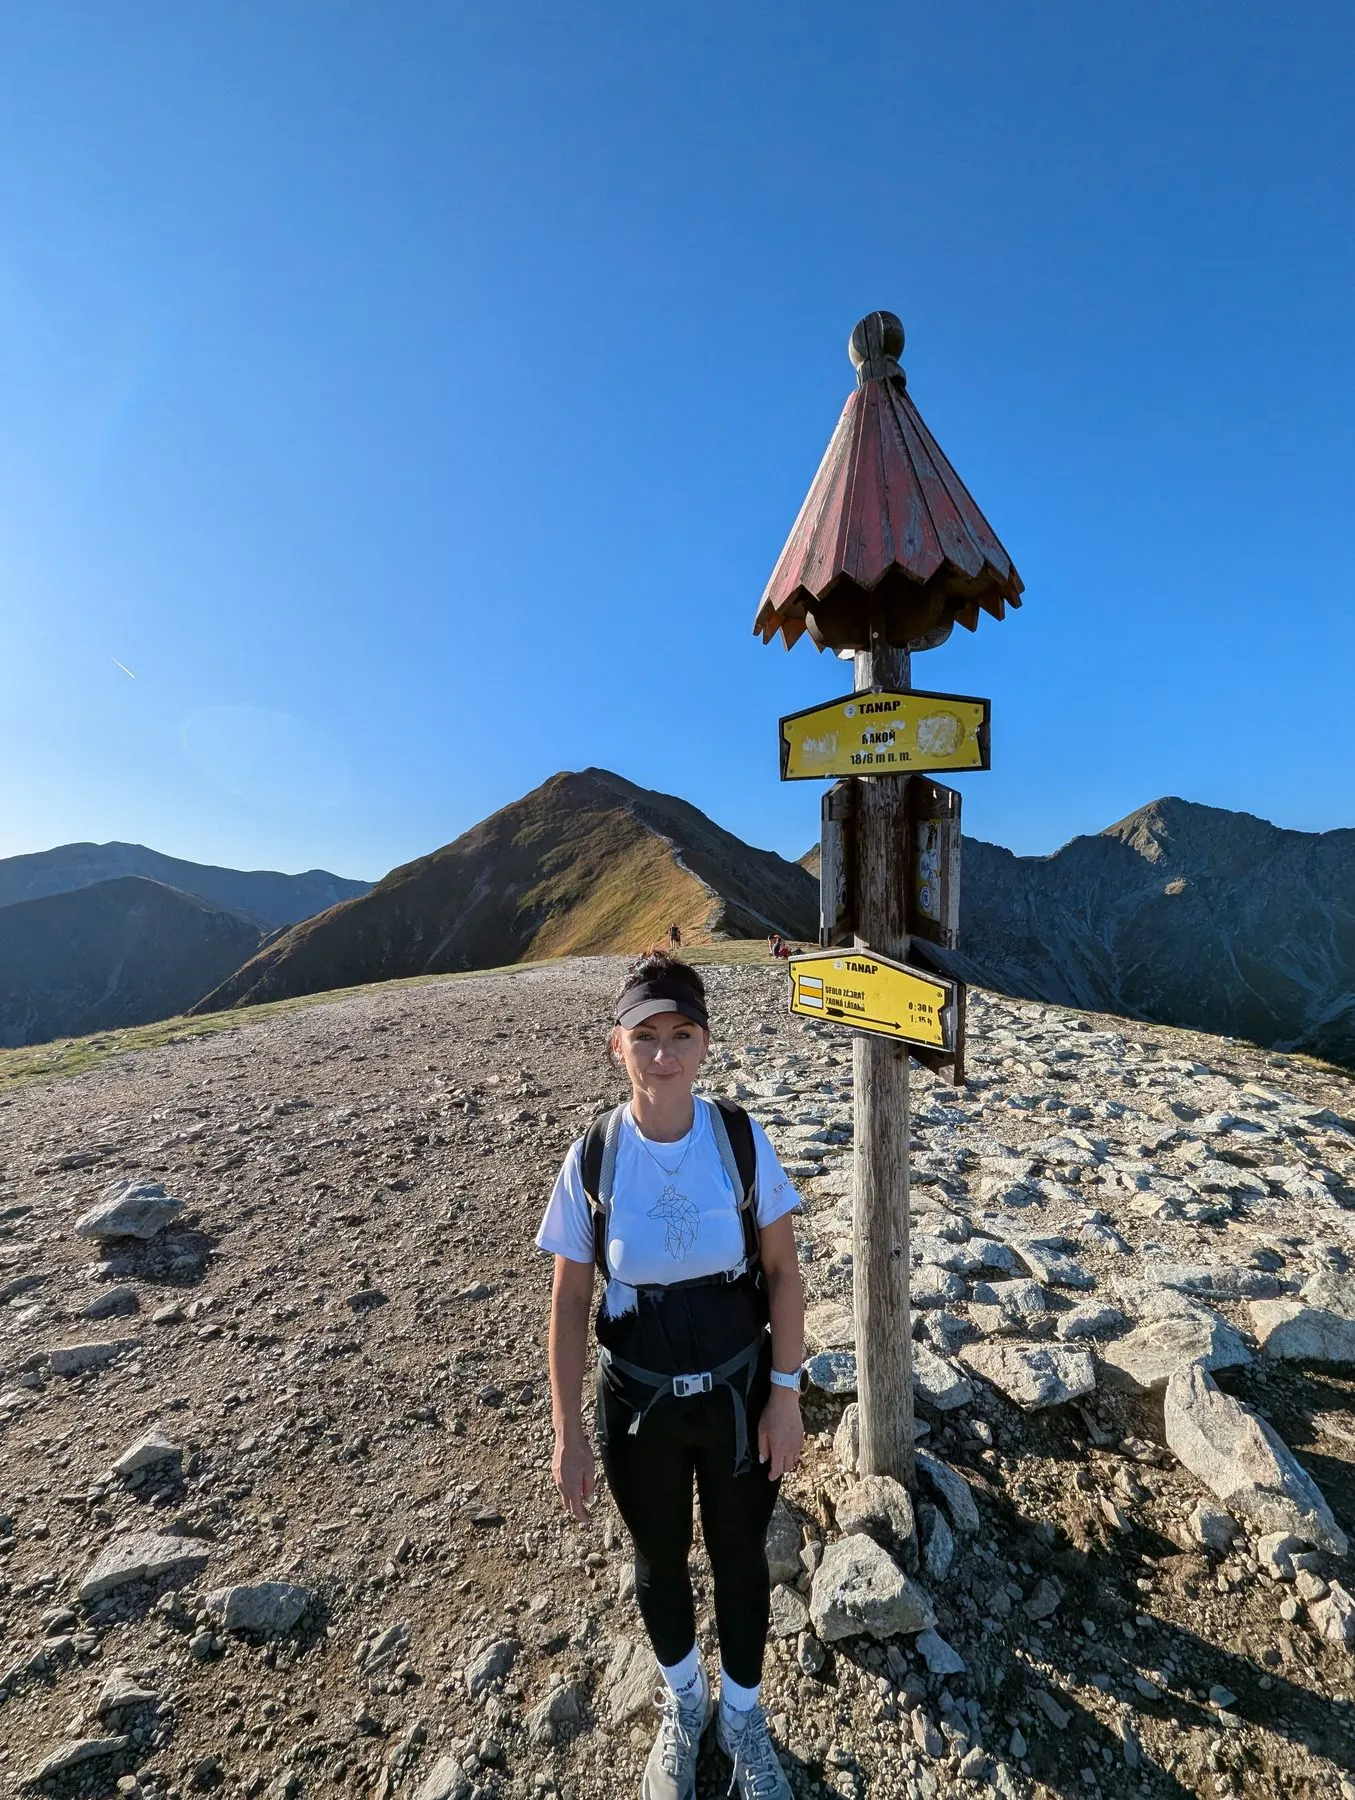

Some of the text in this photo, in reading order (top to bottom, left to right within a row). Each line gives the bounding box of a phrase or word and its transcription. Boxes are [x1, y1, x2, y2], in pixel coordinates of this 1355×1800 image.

[858, 700, 901, 714] TANAP
[876, 753, 885, 763] m
[888, 753, 897, 762] n.
[900, 752, 912, 762] m.
[845, 961, 879, 975] TANAP
[908, 1001, 933, 1013] 0:30 h
